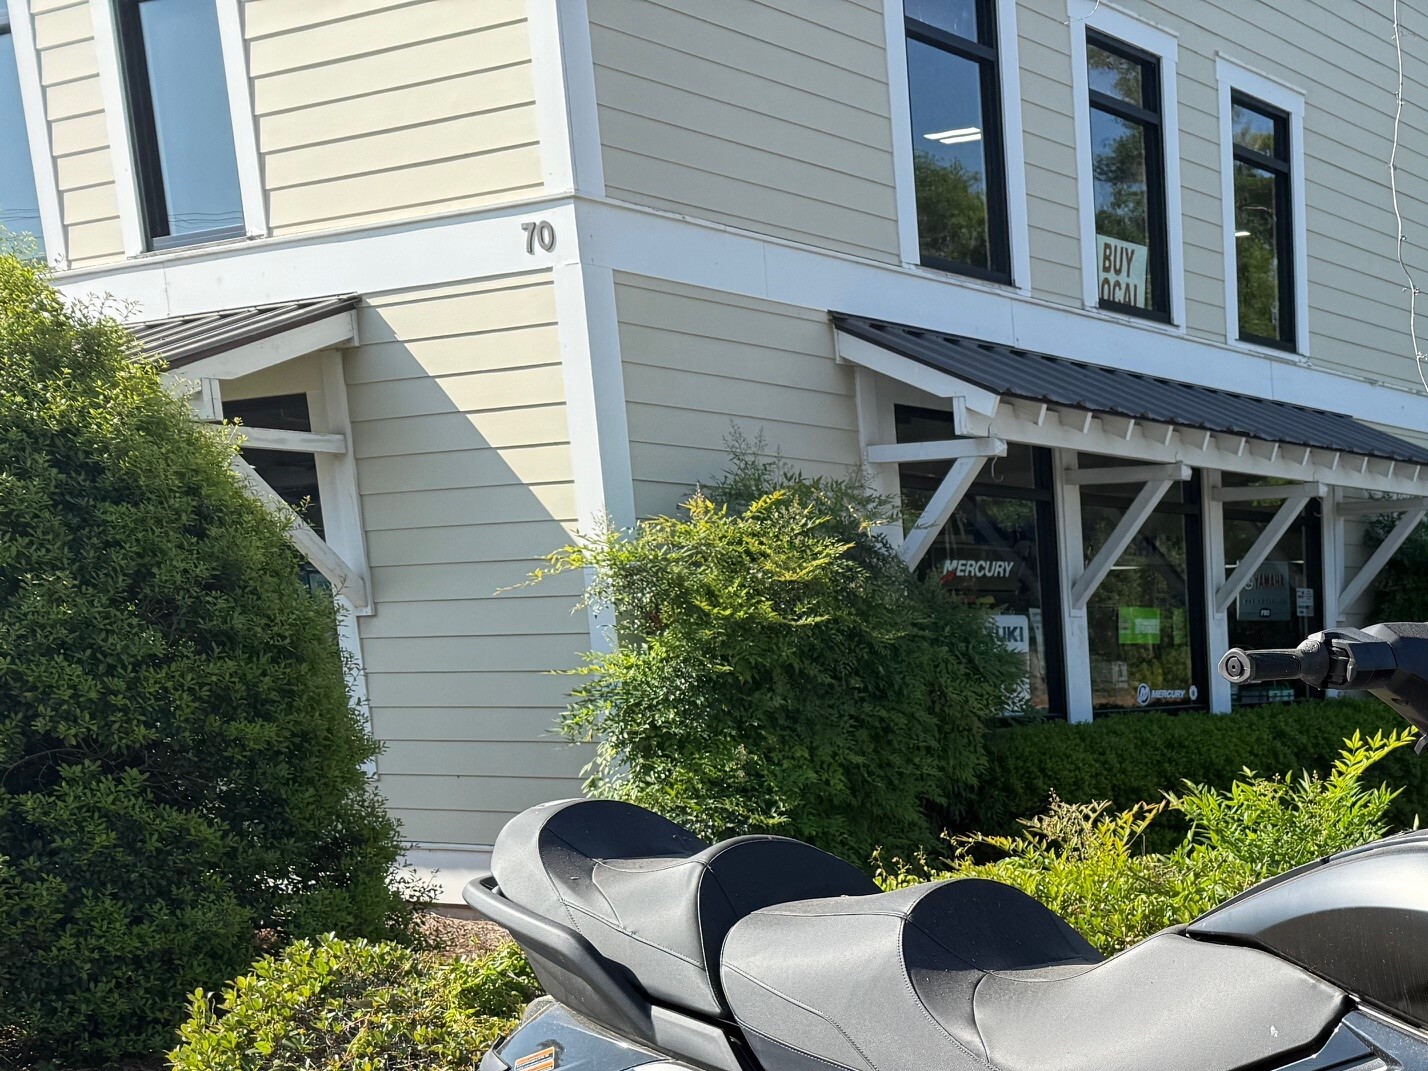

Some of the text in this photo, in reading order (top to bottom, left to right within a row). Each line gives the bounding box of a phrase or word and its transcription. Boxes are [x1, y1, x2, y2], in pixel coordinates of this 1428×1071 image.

[521, 220, 557, 255] 70
[1102, 242, 1135, 278] BUY
[1100, 277, 1138, 307] OCAL
[942, 559, 1015, 578] MERCURY
[1151, 688, 1186, 699] MERCURY
